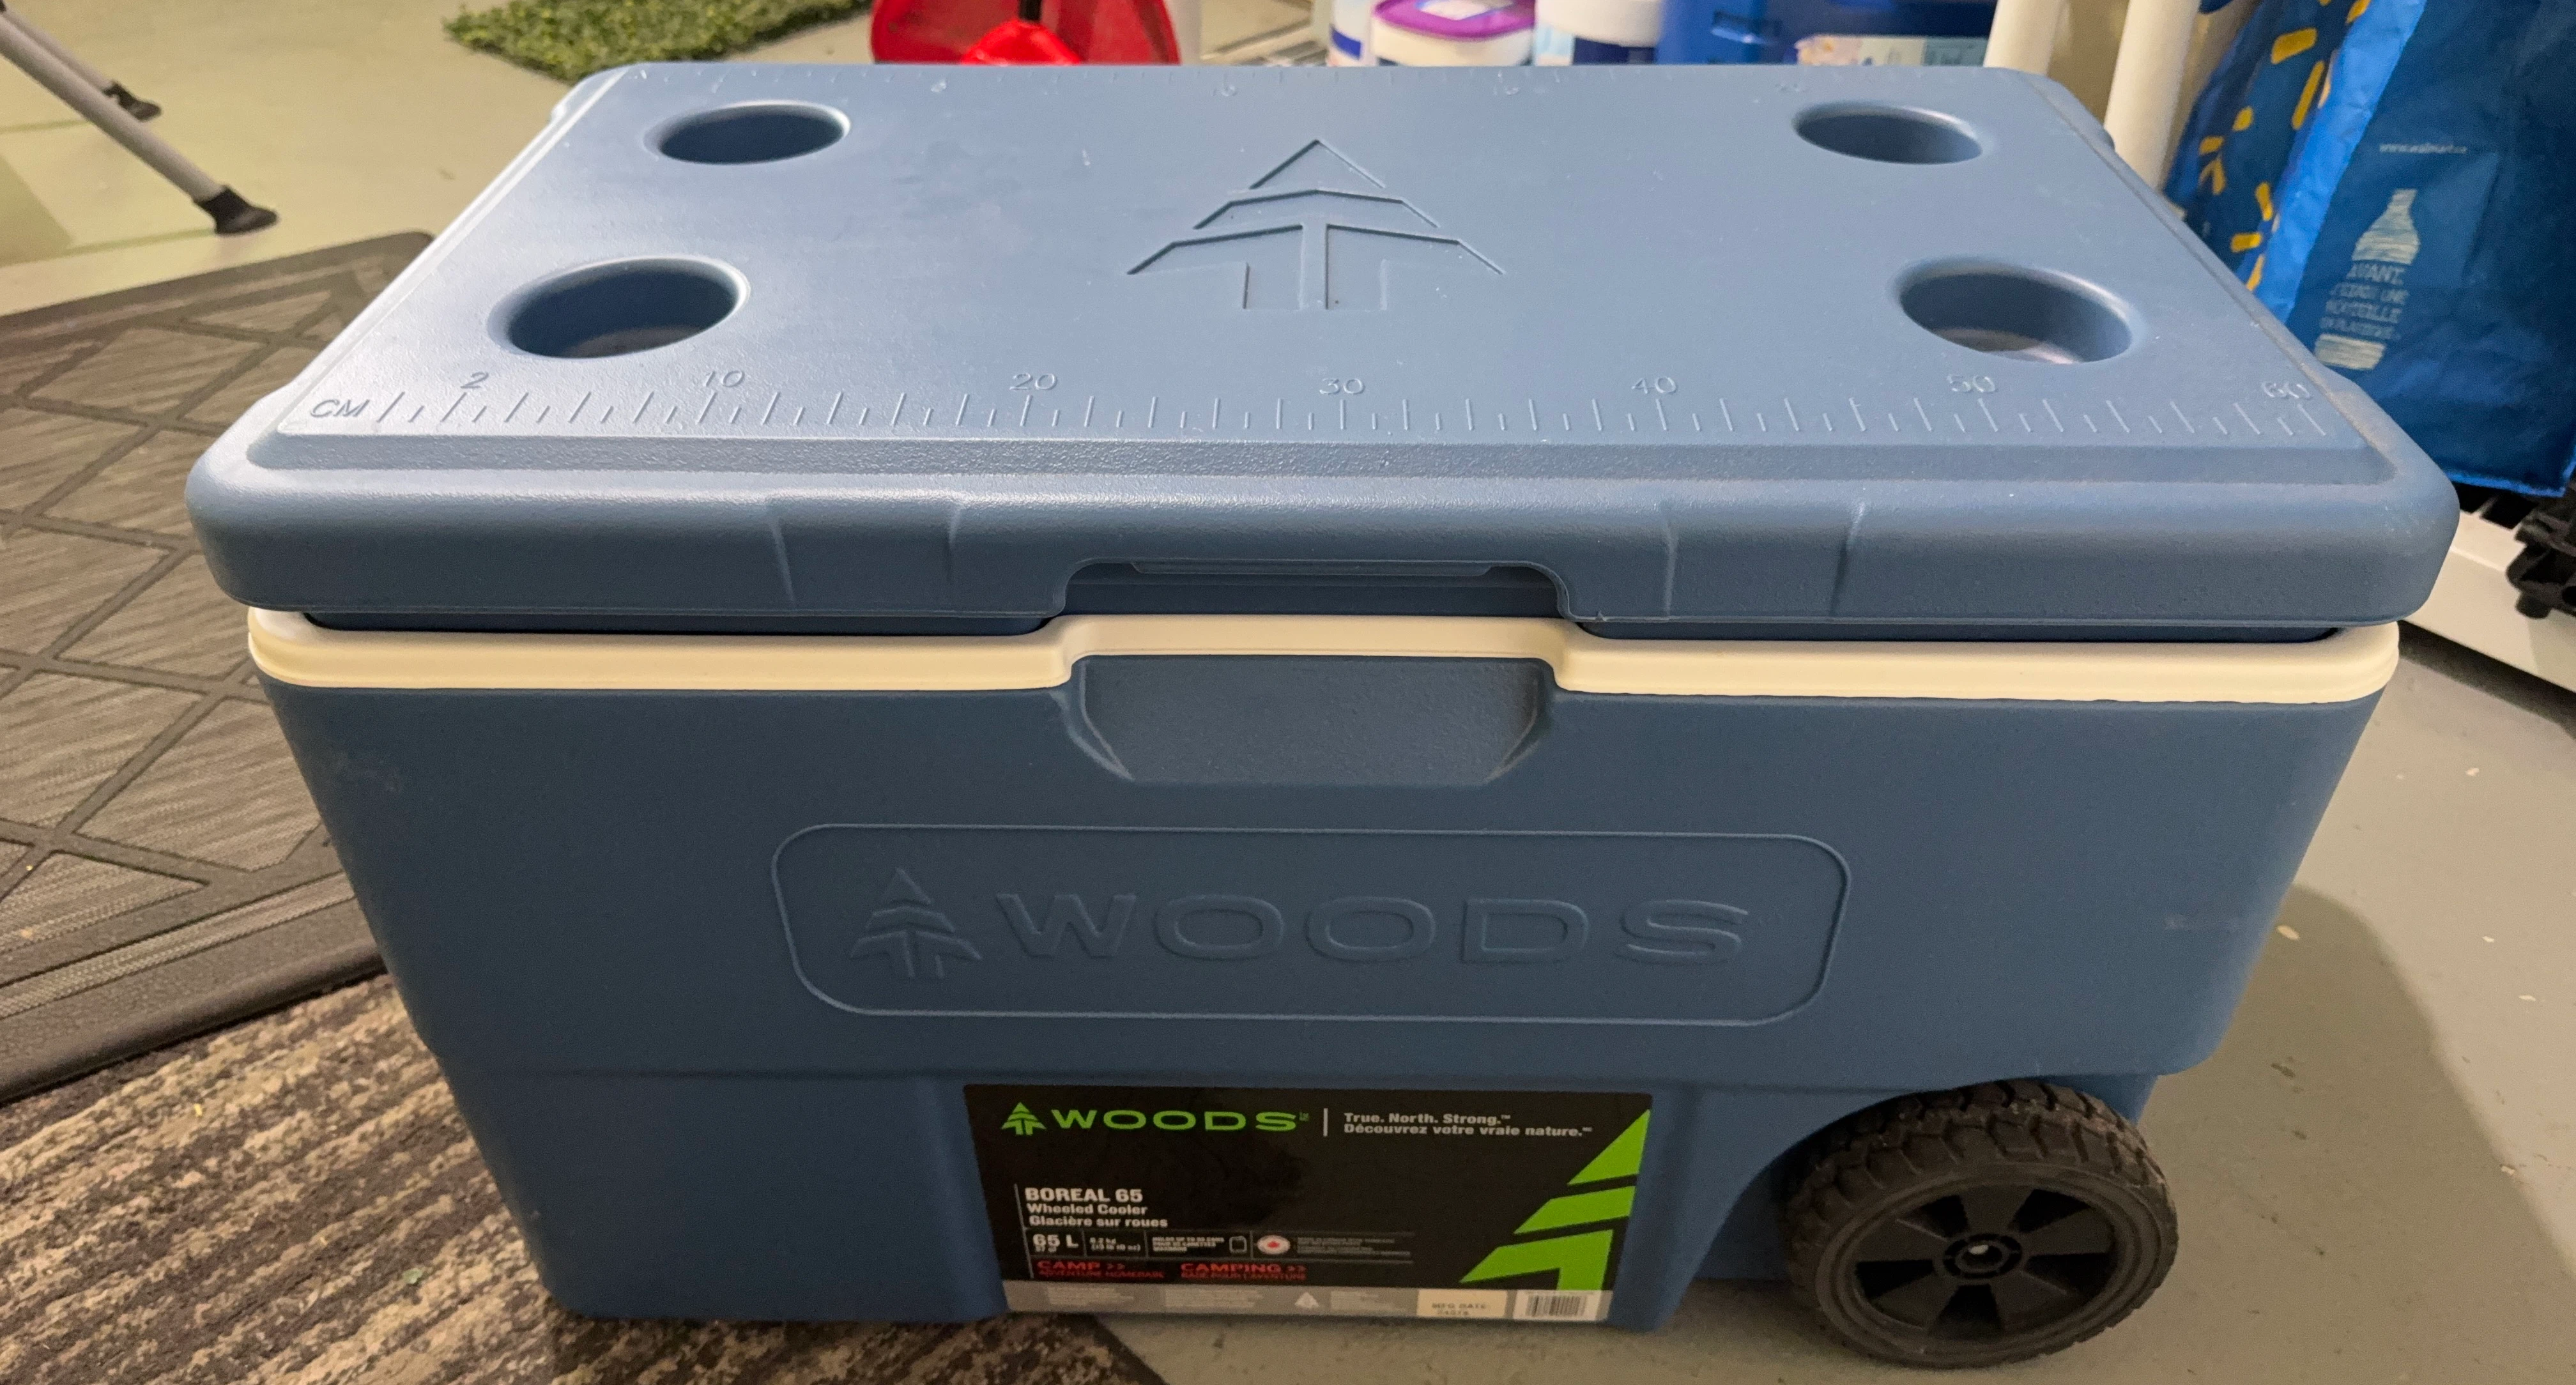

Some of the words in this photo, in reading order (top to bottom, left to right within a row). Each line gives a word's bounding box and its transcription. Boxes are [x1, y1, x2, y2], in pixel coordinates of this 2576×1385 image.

[460, 371, 490, 390] 2
[702, 370, 746, 388] 10
[1009, 372, 1058, 391] 20
[1319, 378, 1365, 395] 30
[1631, 376, 1678, 395] 40
[1947, 374, 1997, 393] 50
[310, 399, 369, 418] CM
[994, 890, 1751, 962] WOODS
[1050, 1109, 1298, 1132] WOODS
[1344, 1112, 1385, 1123] True.
[1388, 1113, 1439, 1124] North.
[1344, 1123, 1428, 1135] Découvrez
[1432, 1124, 1475, 1135] votre
[1479, 1125, 1521, 1136] vraie
[1024, 1187, 1110, 1202] BOREAL
[1115, 1188, 1144, 1203] 65
[1026, 1203, 1094, 1214] Wheeled
[1097, 1204, 1148, 1216] Cooler
[1029, 1215, 1092, 1227] Glacière
[1096, 1218, 1121, 1227] sur
[1125, 1218, 1169, 1228] roues
[1032, 1234, 1061, 1248] 65
[1065, 1234, 1080, 1248] L
[1036, 1260, 1101, 1271] CAMP
[1180, 1262, 1282, 1273] CAMPING
